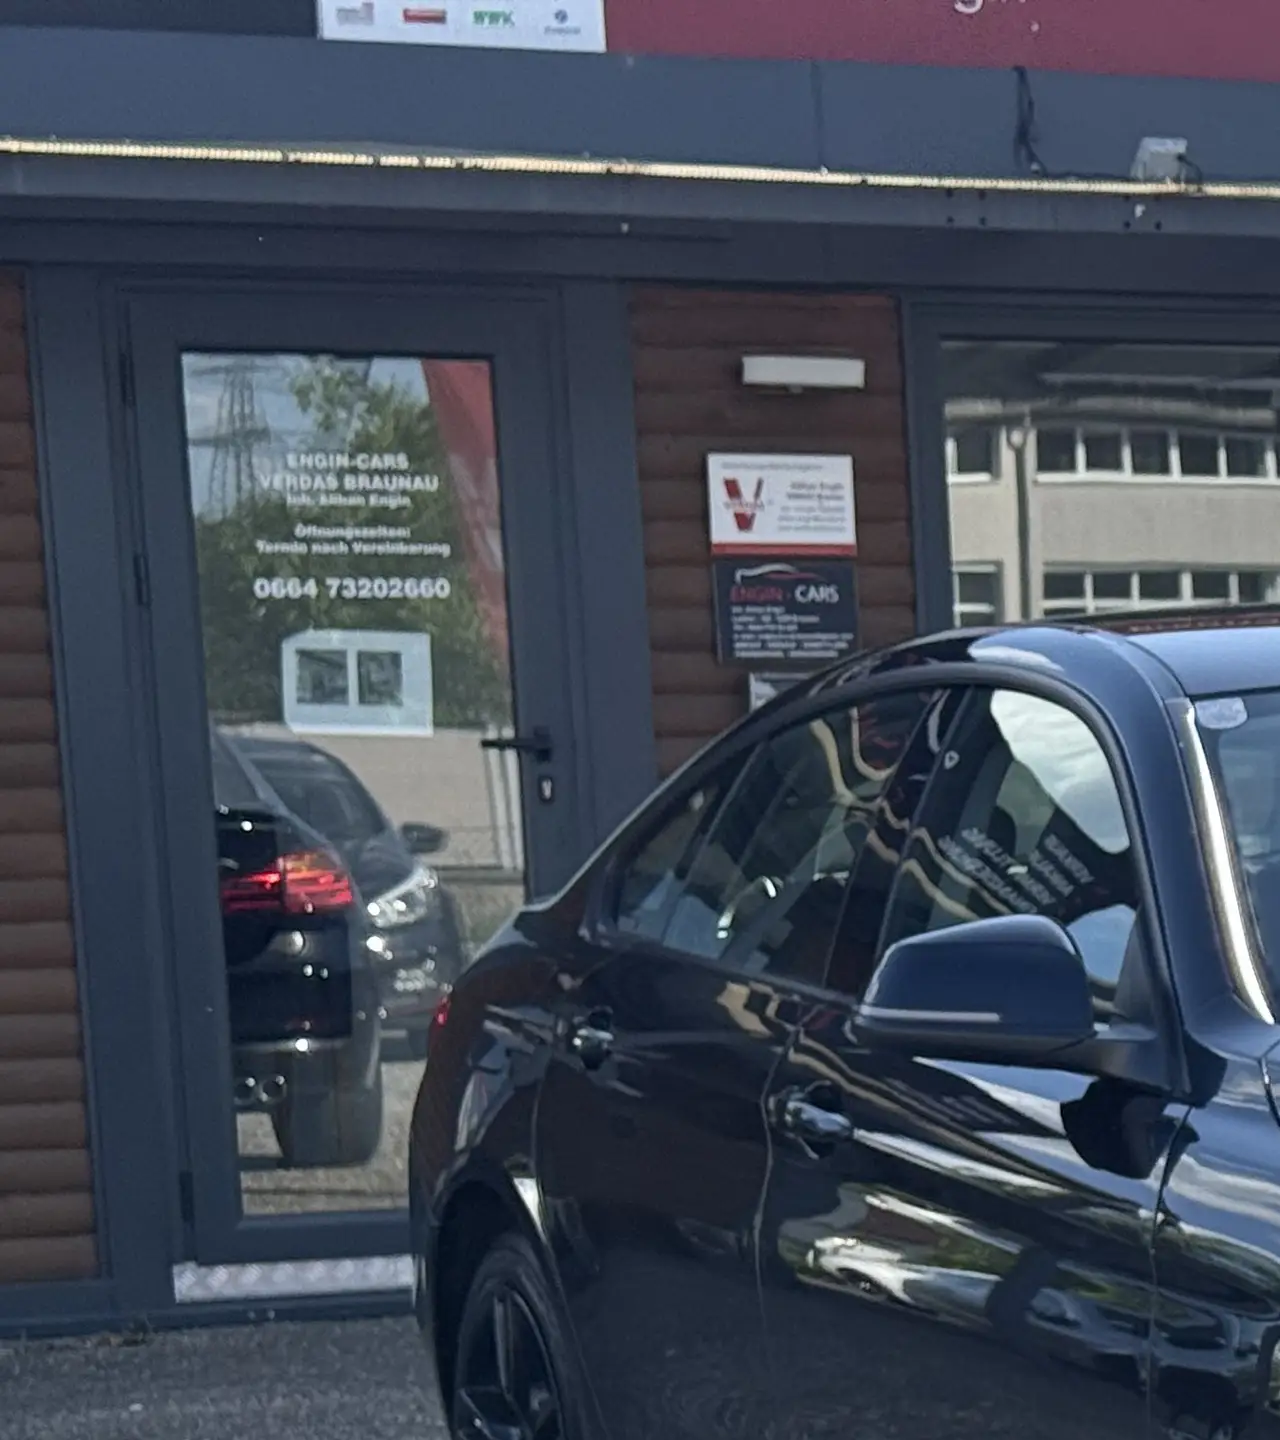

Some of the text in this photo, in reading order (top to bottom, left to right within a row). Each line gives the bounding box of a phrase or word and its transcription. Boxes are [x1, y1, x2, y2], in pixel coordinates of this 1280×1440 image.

[473, 10, 515, 27] WWK
[286, 453, 410, 470] ENGIN-CARS
[258, 474, 439, 492] VERDAS BRAUNAU
[256, 539, 451, 558] Termin nach Vereinbarung
[254, 577, 451, 599] 0664 73202660
[794, 584, 840, 603] CARS
